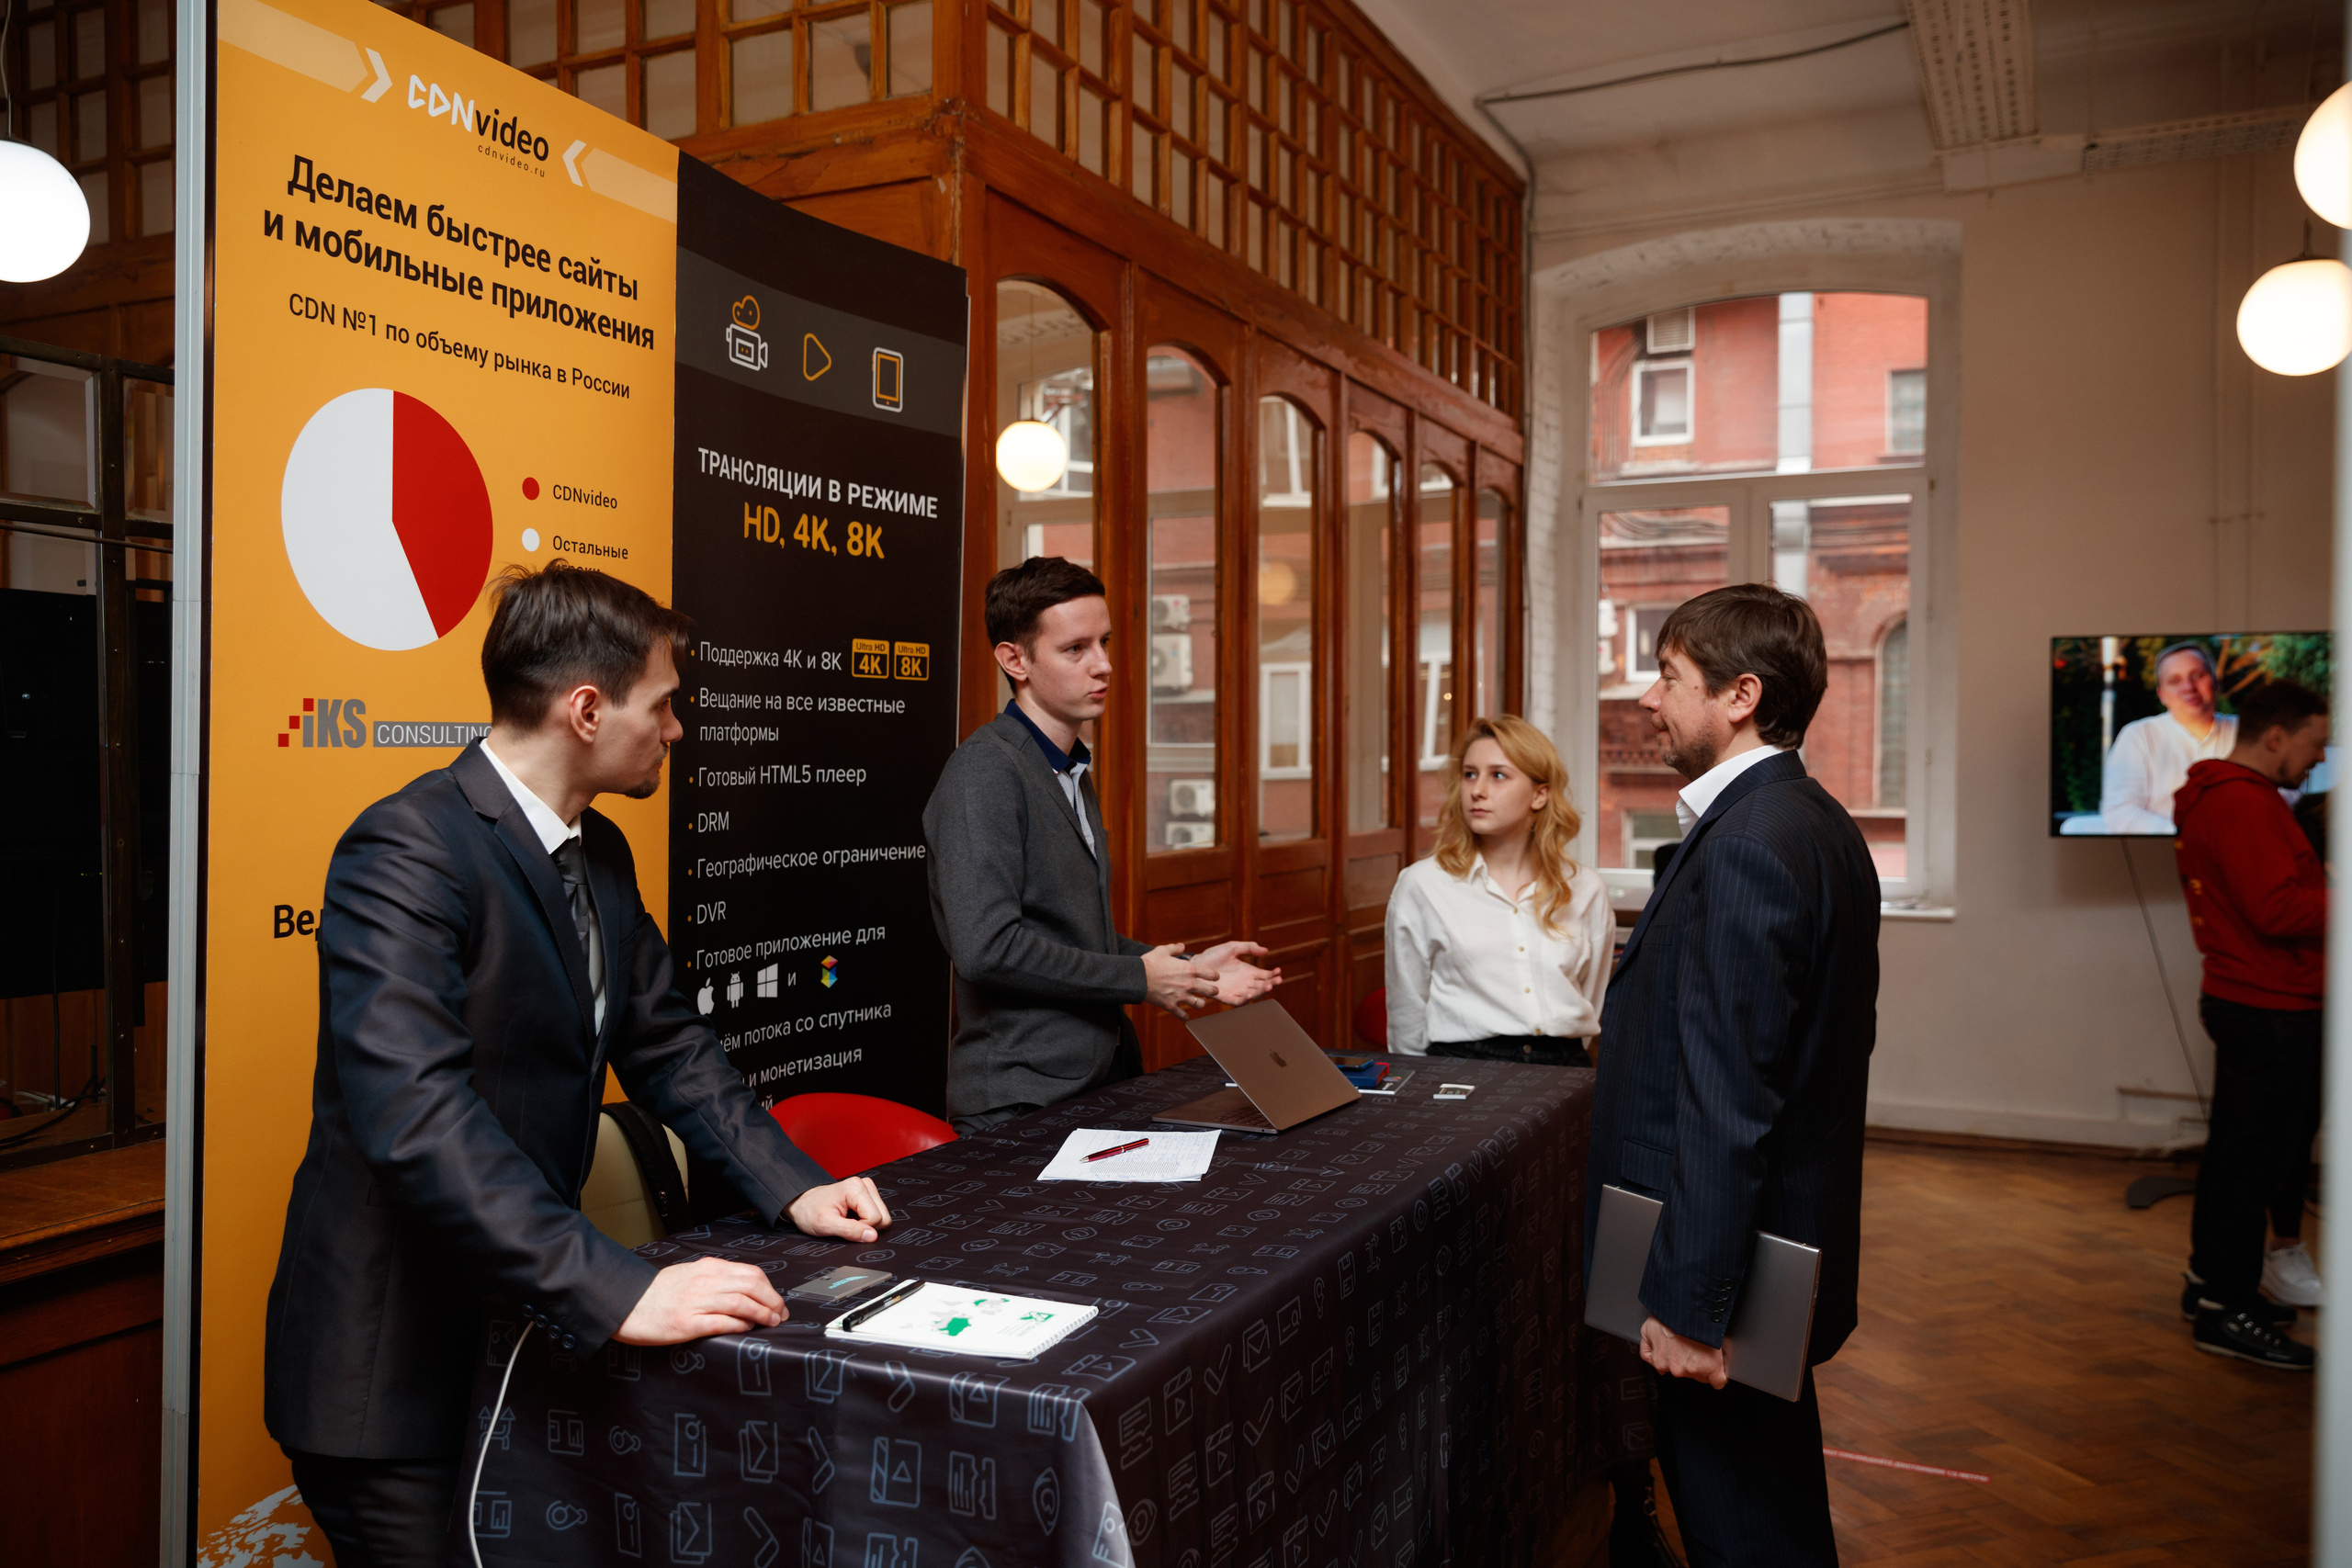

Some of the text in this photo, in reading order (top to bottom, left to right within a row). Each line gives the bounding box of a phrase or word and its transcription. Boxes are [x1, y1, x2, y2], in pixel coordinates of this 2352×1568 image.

[408, 73, 548, 161] CDNvideo
[478, 144, 545, 177] cdnvideo.ru
[288, 155, 639, 300] Делаем быстрее сайты
[264, 209, 655, 351] и мобильные приложения
[288, 293, 630, 400] CDN №1 по объему рынка в России
[552, 485, 618, 509] CDNvideo
[698, 447, 938, 519] ТРАНСЛЯЦИИ В РЕЖИМЕ
[743, 502, 885, 559] HD, 4K, 8K
[553, 536, 628, 559] Остальные
[700, 641, 779, 669] Поддержка
[807, 654, 816, 669] и
[855, 642, 886, 652] Ultra HD
[898, 645, 914, 654] Ultra
[859, 654, 882, 674] 4K
[900, 656, 922, 676] 8K
[699, 688, 906, 714] Вещание на все известные
[302, 698, 367, 748] iKS
[699, 722, 779, 745] платформы
[698, 765, 866, 787] Готовый HTML5 плеер
[697, 811, 729, 833] DRM
[697, 845, 926, 878] Географическое ограничение
[696, 900, 727, 924] DVR
[696, 926, 886, 970] Готовое приложение для
[787, 972, 797, 987] и
[744, 1021, 791, 1046] потока
[796, 1016, 814, 1032] со
[819, 1003, 891, 1030] спутника
[749, 1048, 862, 1088] и монетизация
